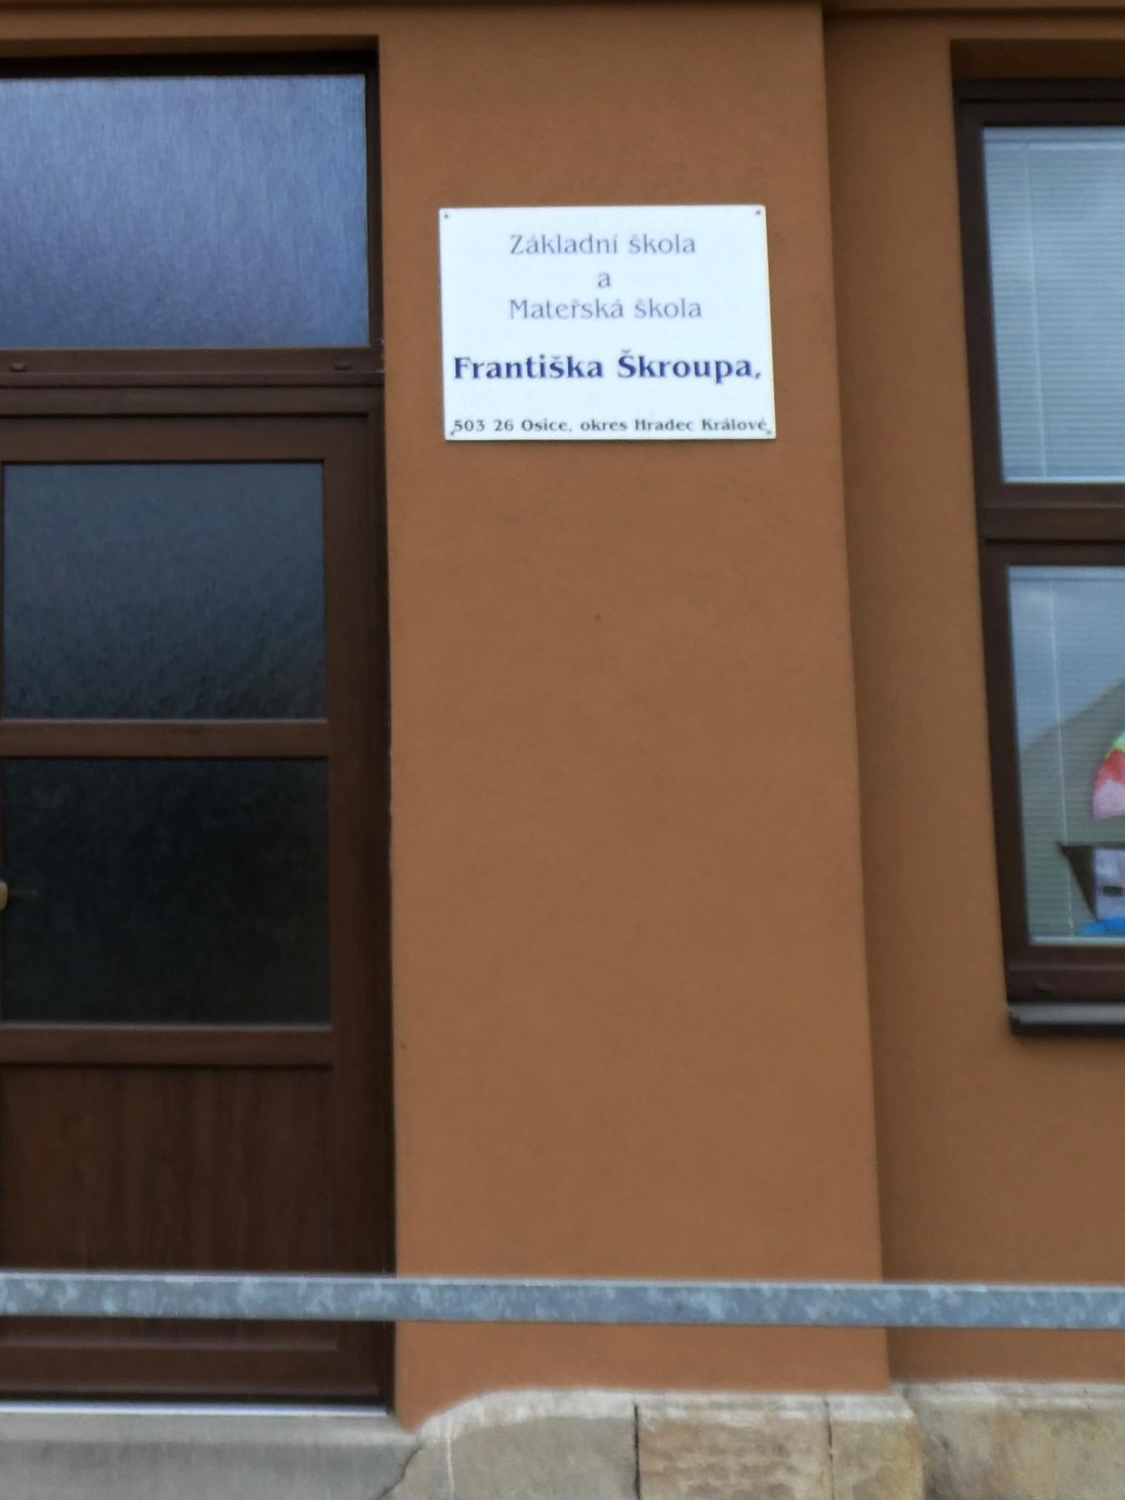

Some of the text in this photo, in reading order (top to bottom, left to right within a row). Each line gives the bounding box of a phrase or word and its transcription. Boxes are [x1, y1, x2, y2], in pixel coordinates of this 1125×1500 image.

[509, 232, 697, 256] Základní škola
[596, 270, 612, 289] a
[509, 296, 703, 320] Mateřská škola
[453, 349, 763, 384] Františka Škroupa,
[453, 417, 768, 433] 503 26 Osice, okres Hradec Králové
